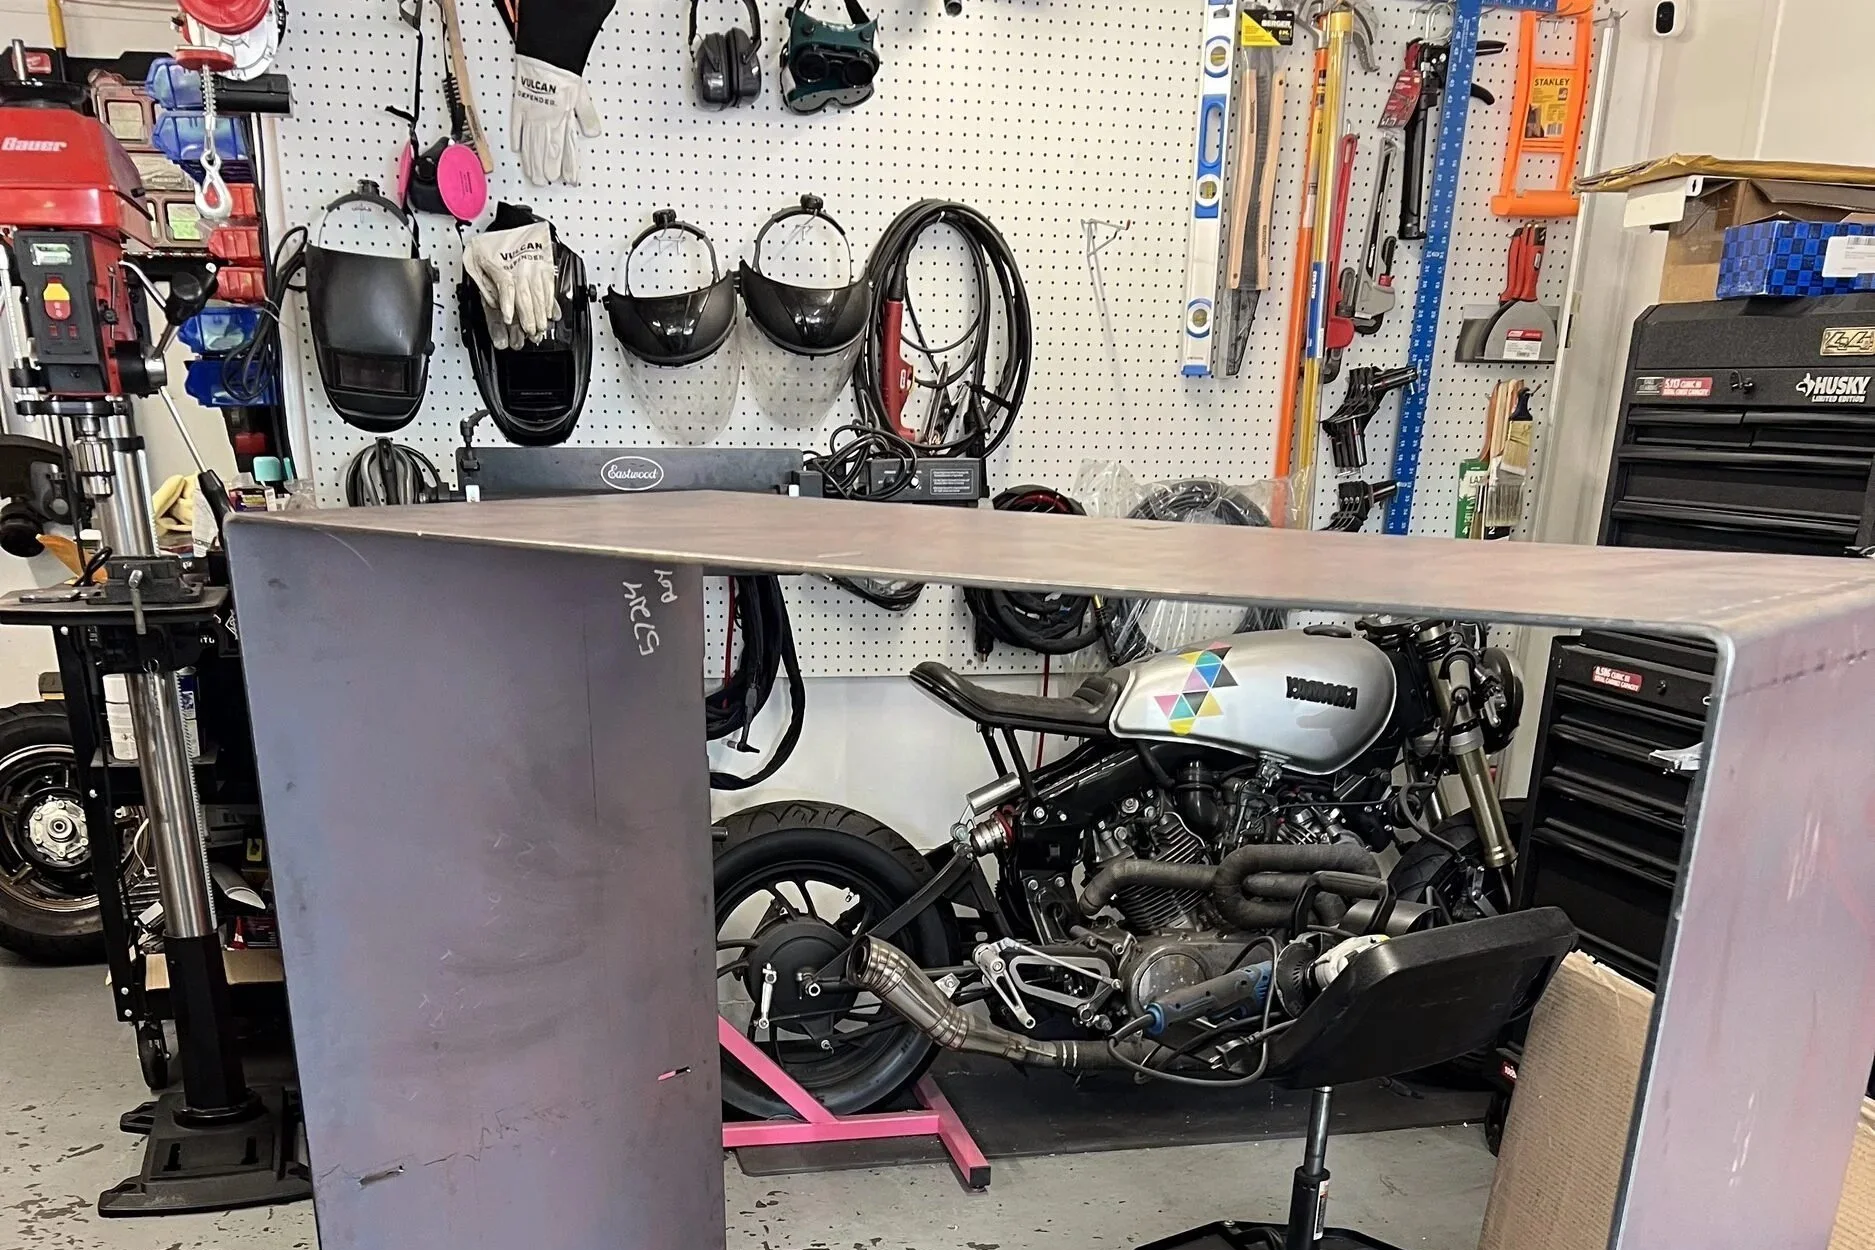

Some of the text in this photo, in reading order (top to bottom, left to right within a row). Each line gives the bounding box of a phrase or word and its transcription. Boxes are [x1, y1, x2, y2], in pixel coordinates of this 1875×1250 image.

[521, 76, 557, 94] VULCAN
[1534, 78, 1571, 86] STANLEY
[1, 136, 68, 152] Bauer
[1813, 376, 1872, 395] HUSKY
[1812, 395, 1866, 403] LIMITED EDITION
[607, 464, 657, 479] Eastwood
